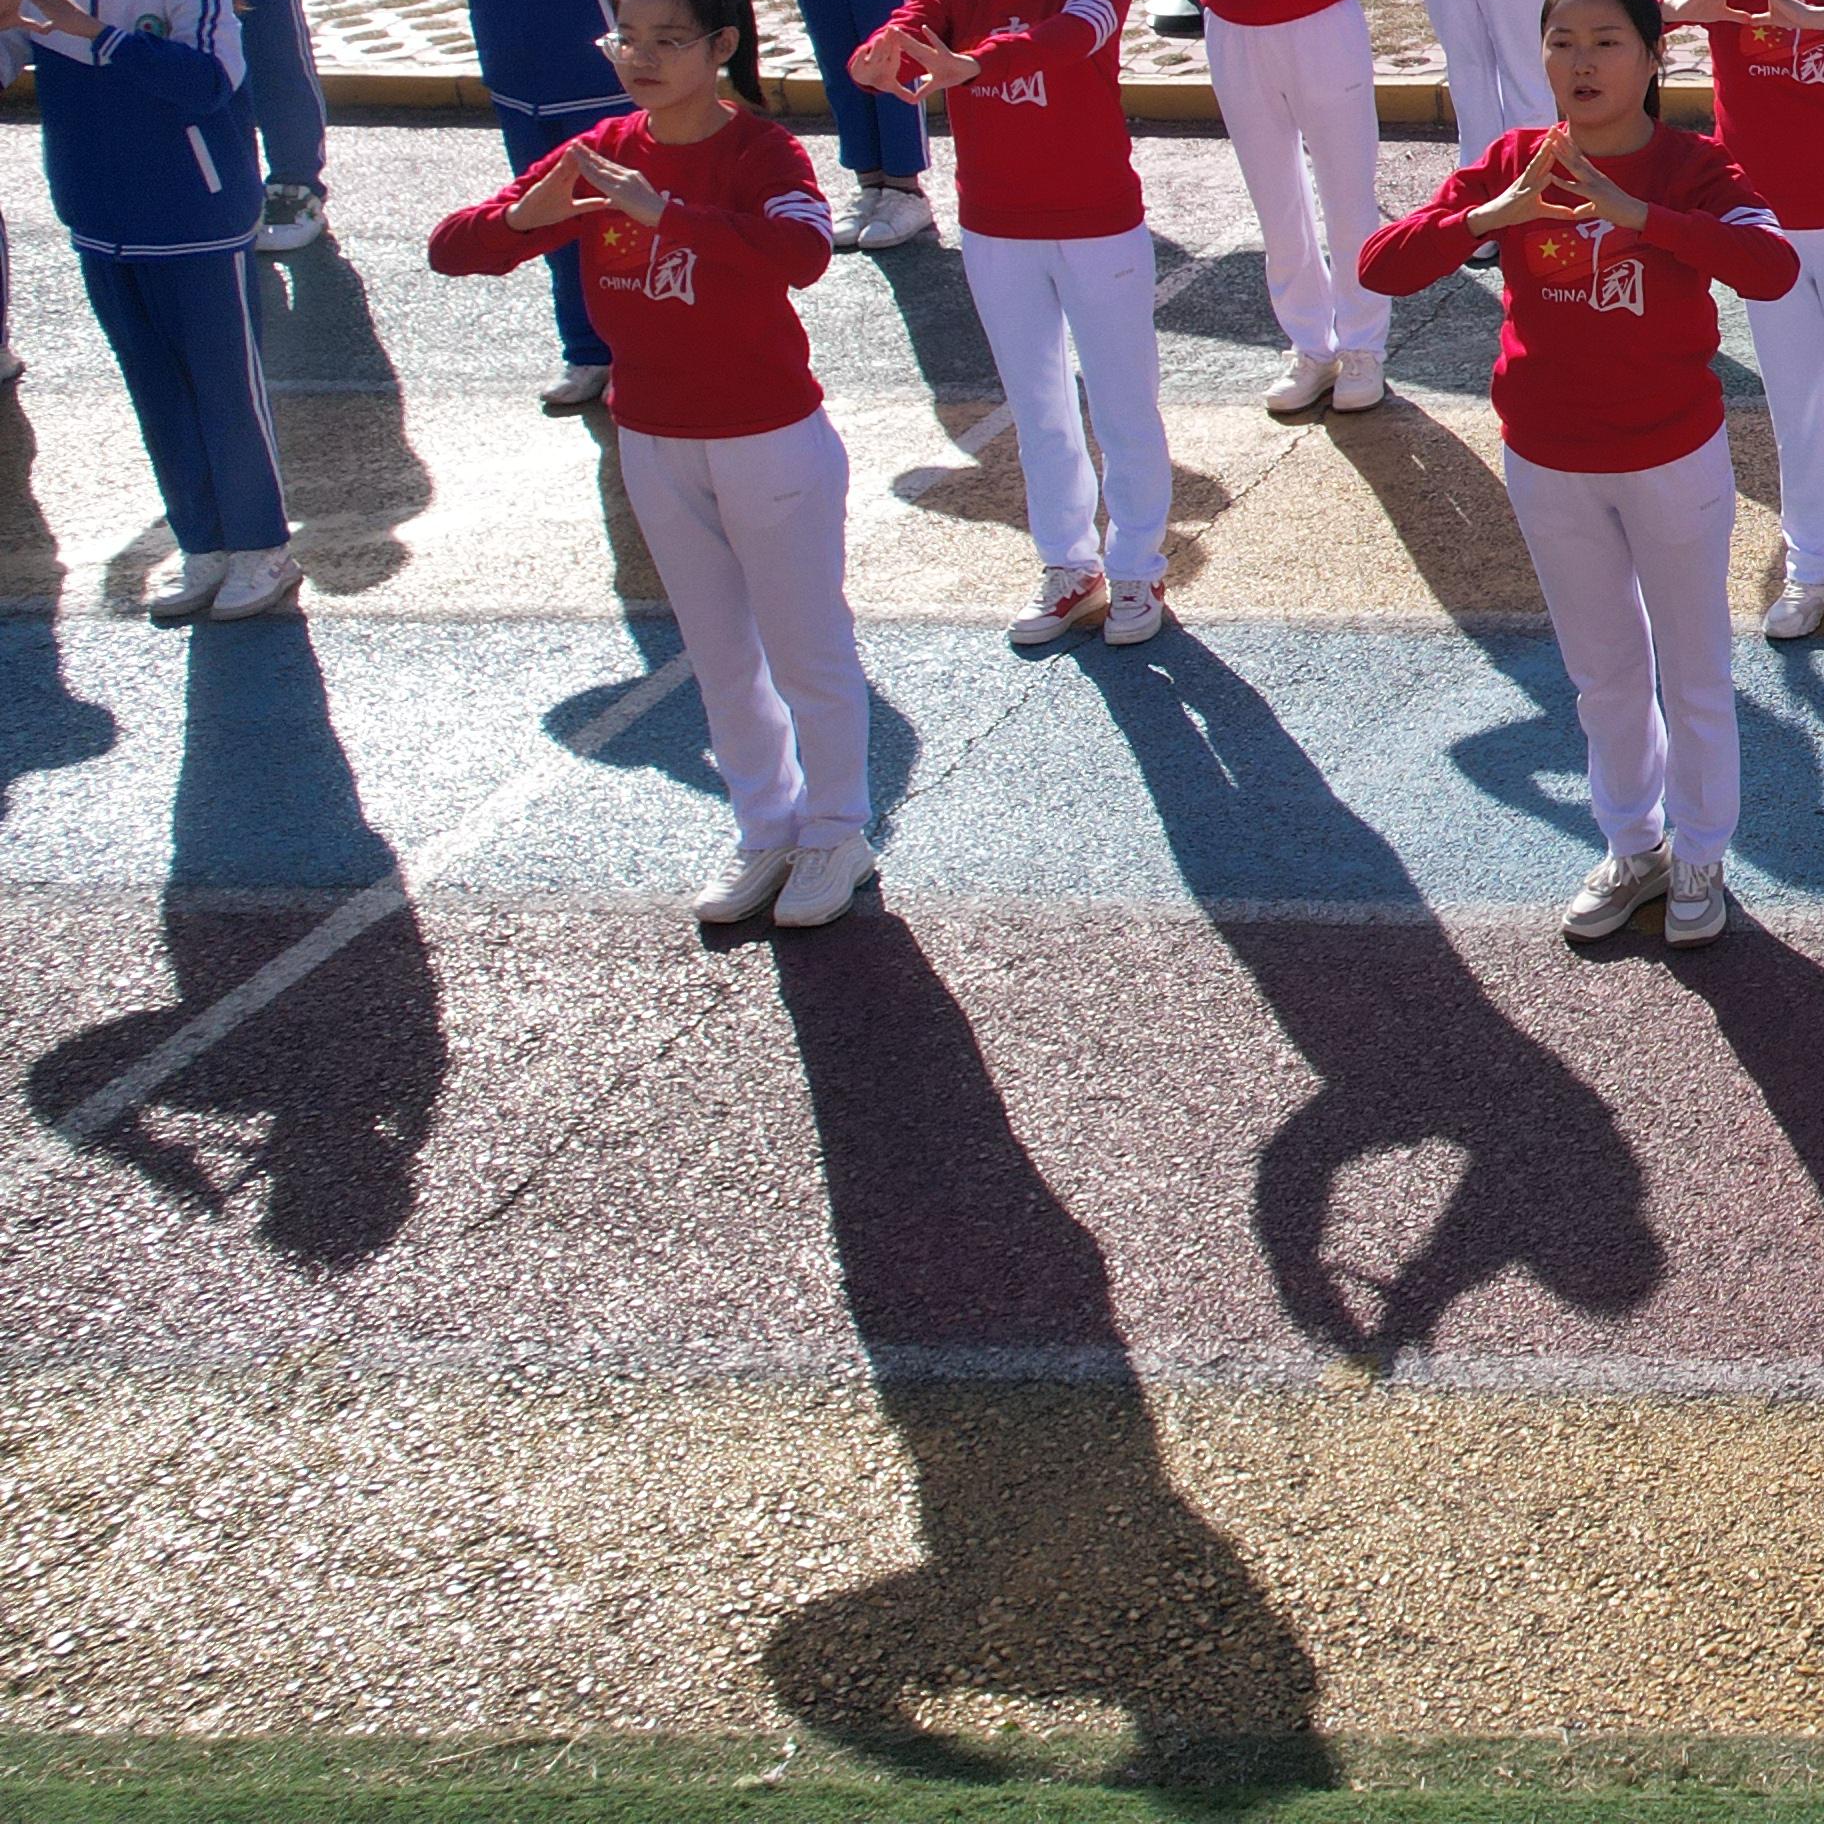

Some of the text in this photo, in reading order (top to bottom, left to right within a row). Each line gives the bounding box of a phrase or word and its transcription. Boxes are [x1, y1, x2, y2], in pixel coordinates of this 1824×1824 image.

[1748, 64, 1791, 76] CHINA
[600, 275, 642, 291] CHINA
[1541, 287, 1588, 303] CHINA
